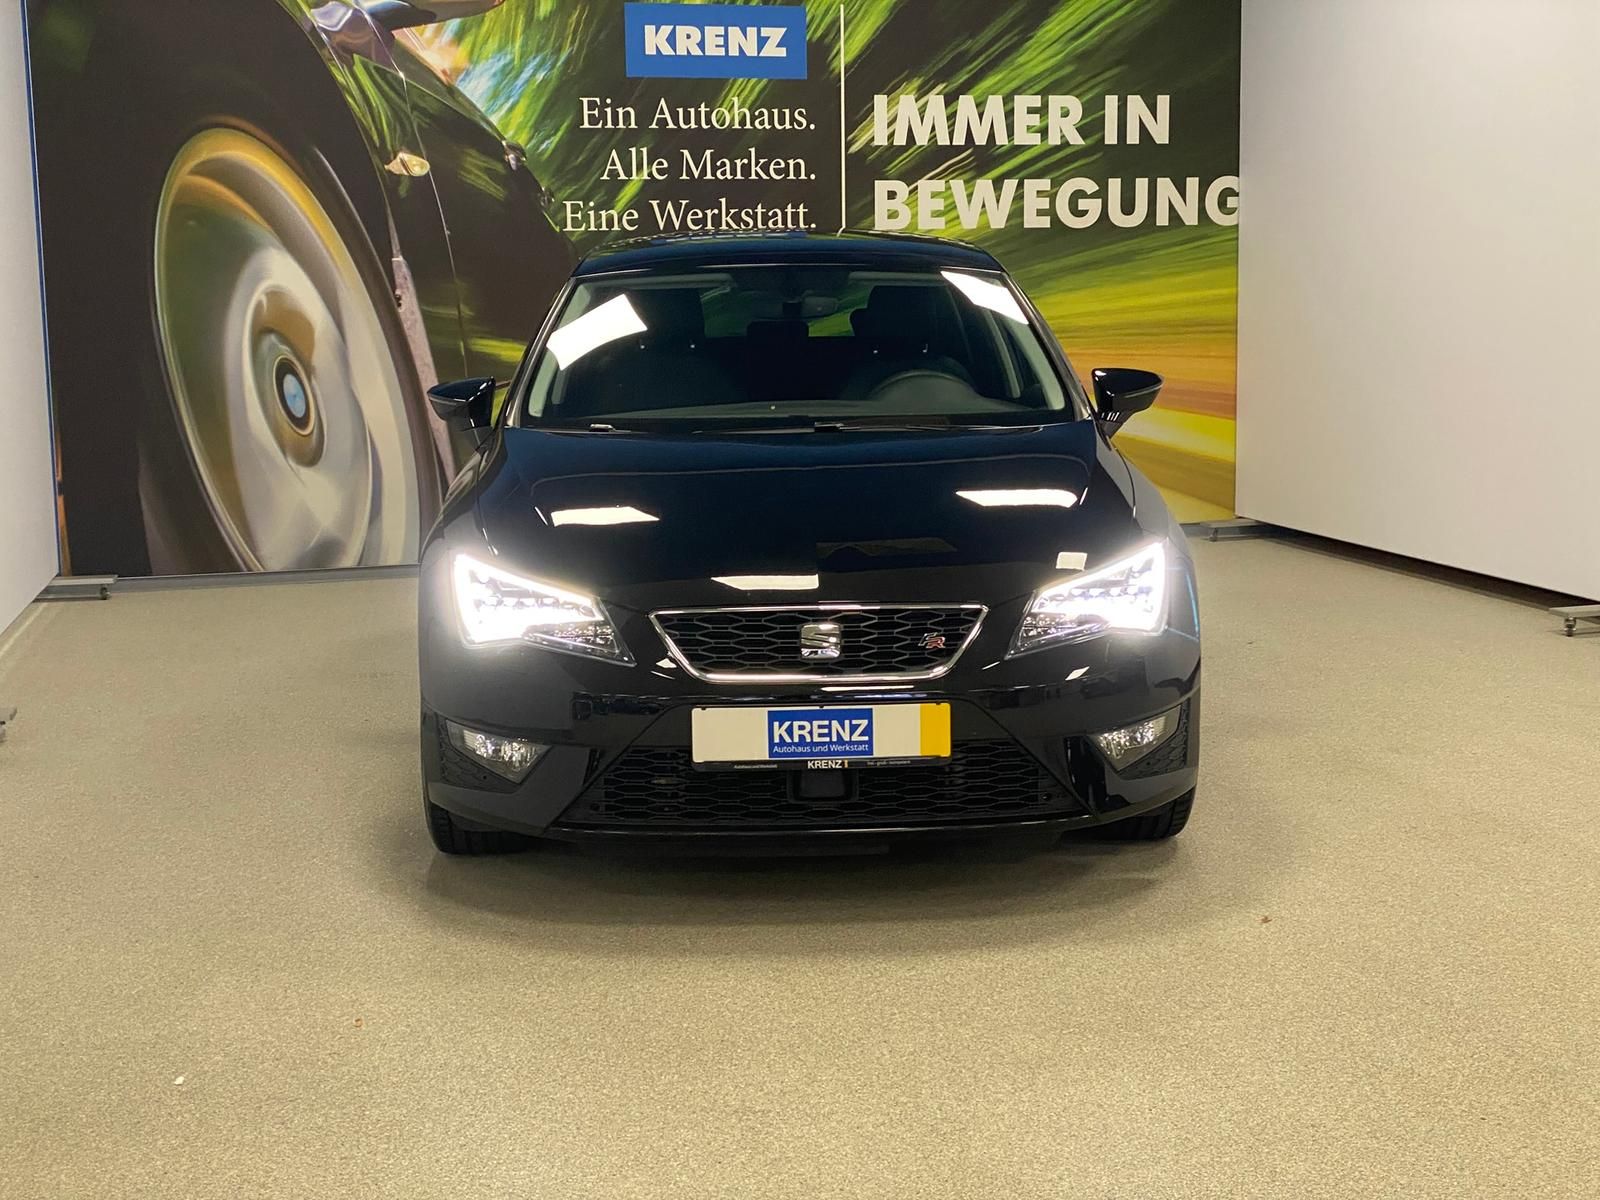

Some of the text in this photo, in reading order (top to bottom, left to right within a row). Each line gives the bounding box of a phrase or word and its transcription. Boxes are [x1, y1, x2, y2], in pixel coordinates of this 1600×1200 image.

[644, 25, 787, 57] KRENZ
[579, 97, 816, 130] Ein Autohaus.
[873, 94, 1171, 146] IMMER IN
[600, 147, 816, 181] Alle Marken.
[562, 198, 817, 231] Eine Werkstatt.
[874, 175, 1240, 230] BEWEGUNG
[773, 719, 869, 743] KRENZ
[773, 745, 811, 753] Autohaus
[830, 743, 869, 752] Werkstatt
[807, 760, 842, 769] KRENZ
